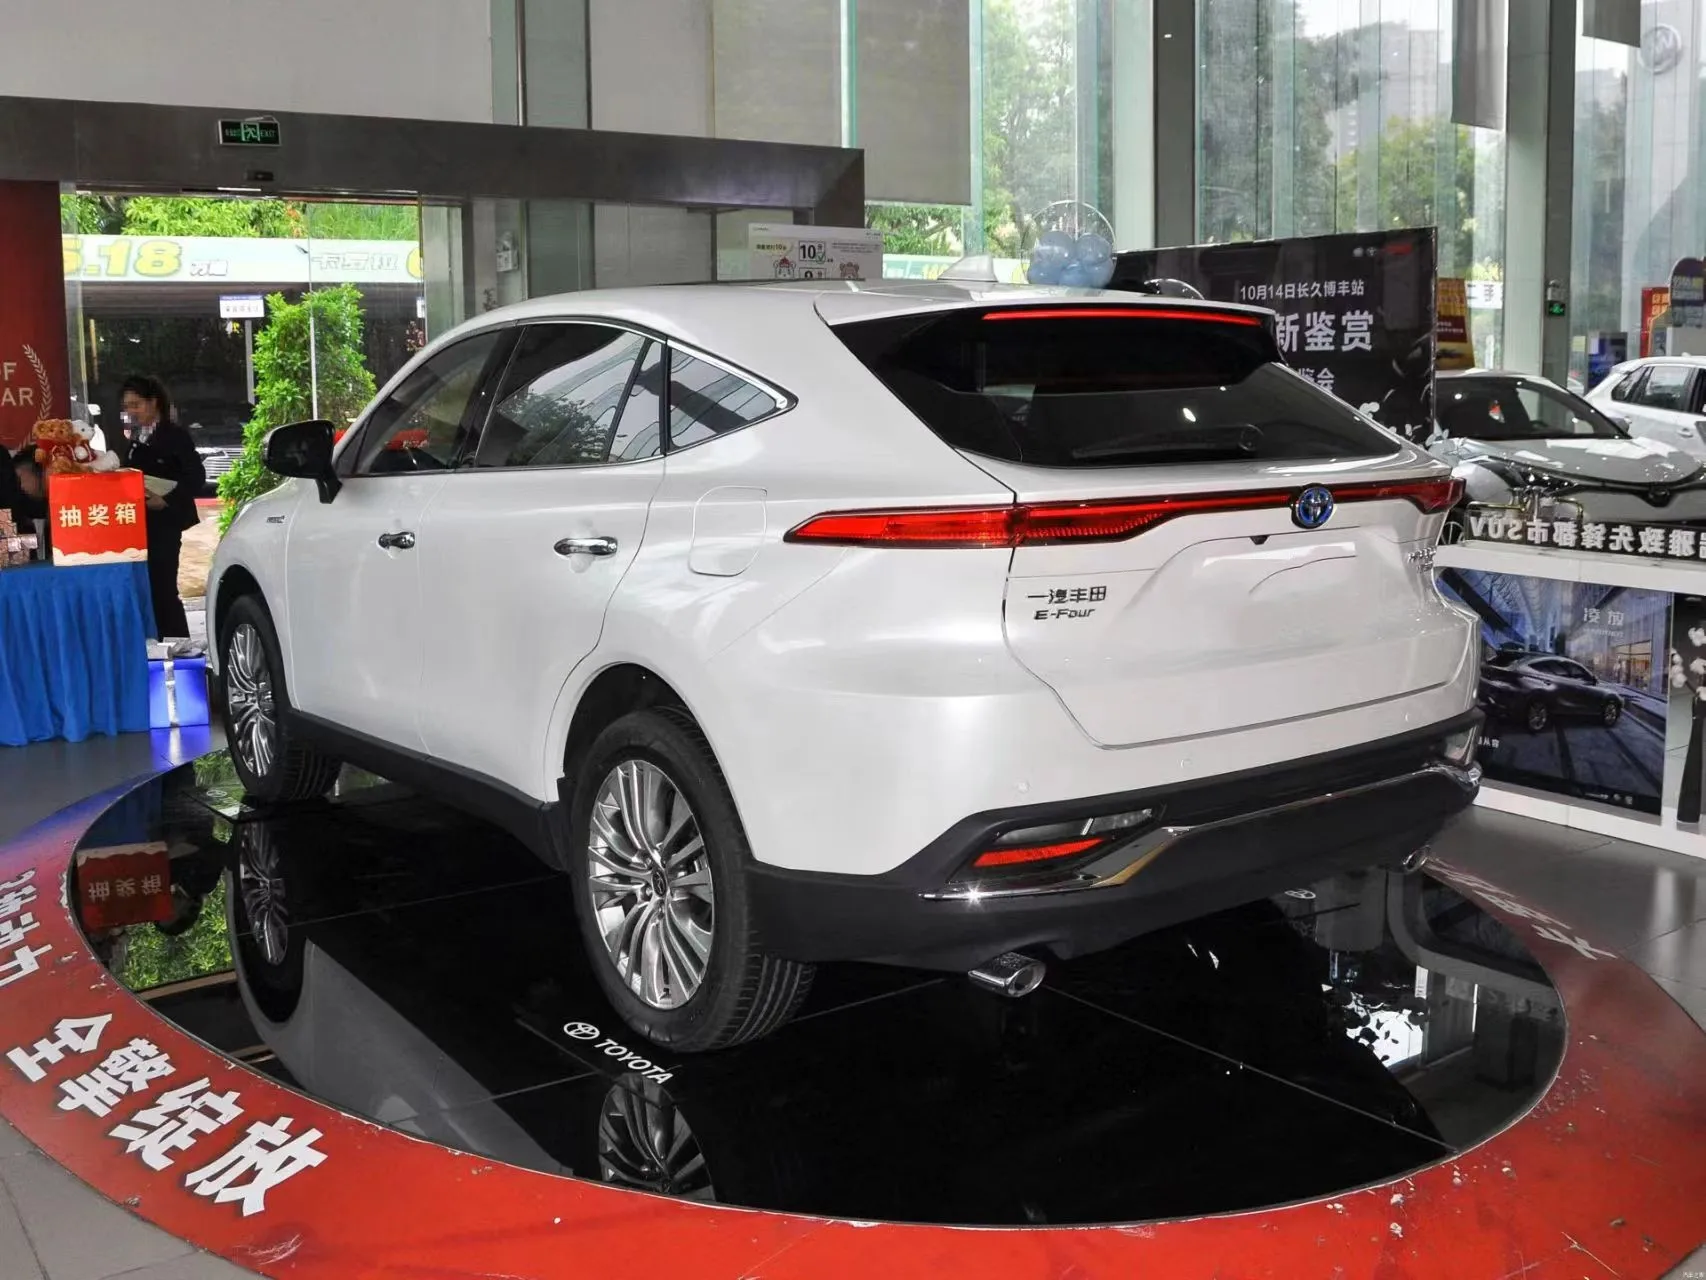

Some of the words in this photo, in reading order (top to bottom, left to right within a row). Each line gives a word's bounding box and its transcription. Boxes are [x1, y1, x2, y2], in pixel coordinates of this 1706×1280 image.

[1240, 280, 1365, 300] 10月14日长久博丰站
[59, 502, 137, 528] 抽奖箱
[1027, 586, 1107, 604] 一汽丰田
[1033, 608, 1096, 621] E-Four
[594, 1038, 674, 1084] TOYOTA
[6, 1013, 329, 1218] 全擎绽放
